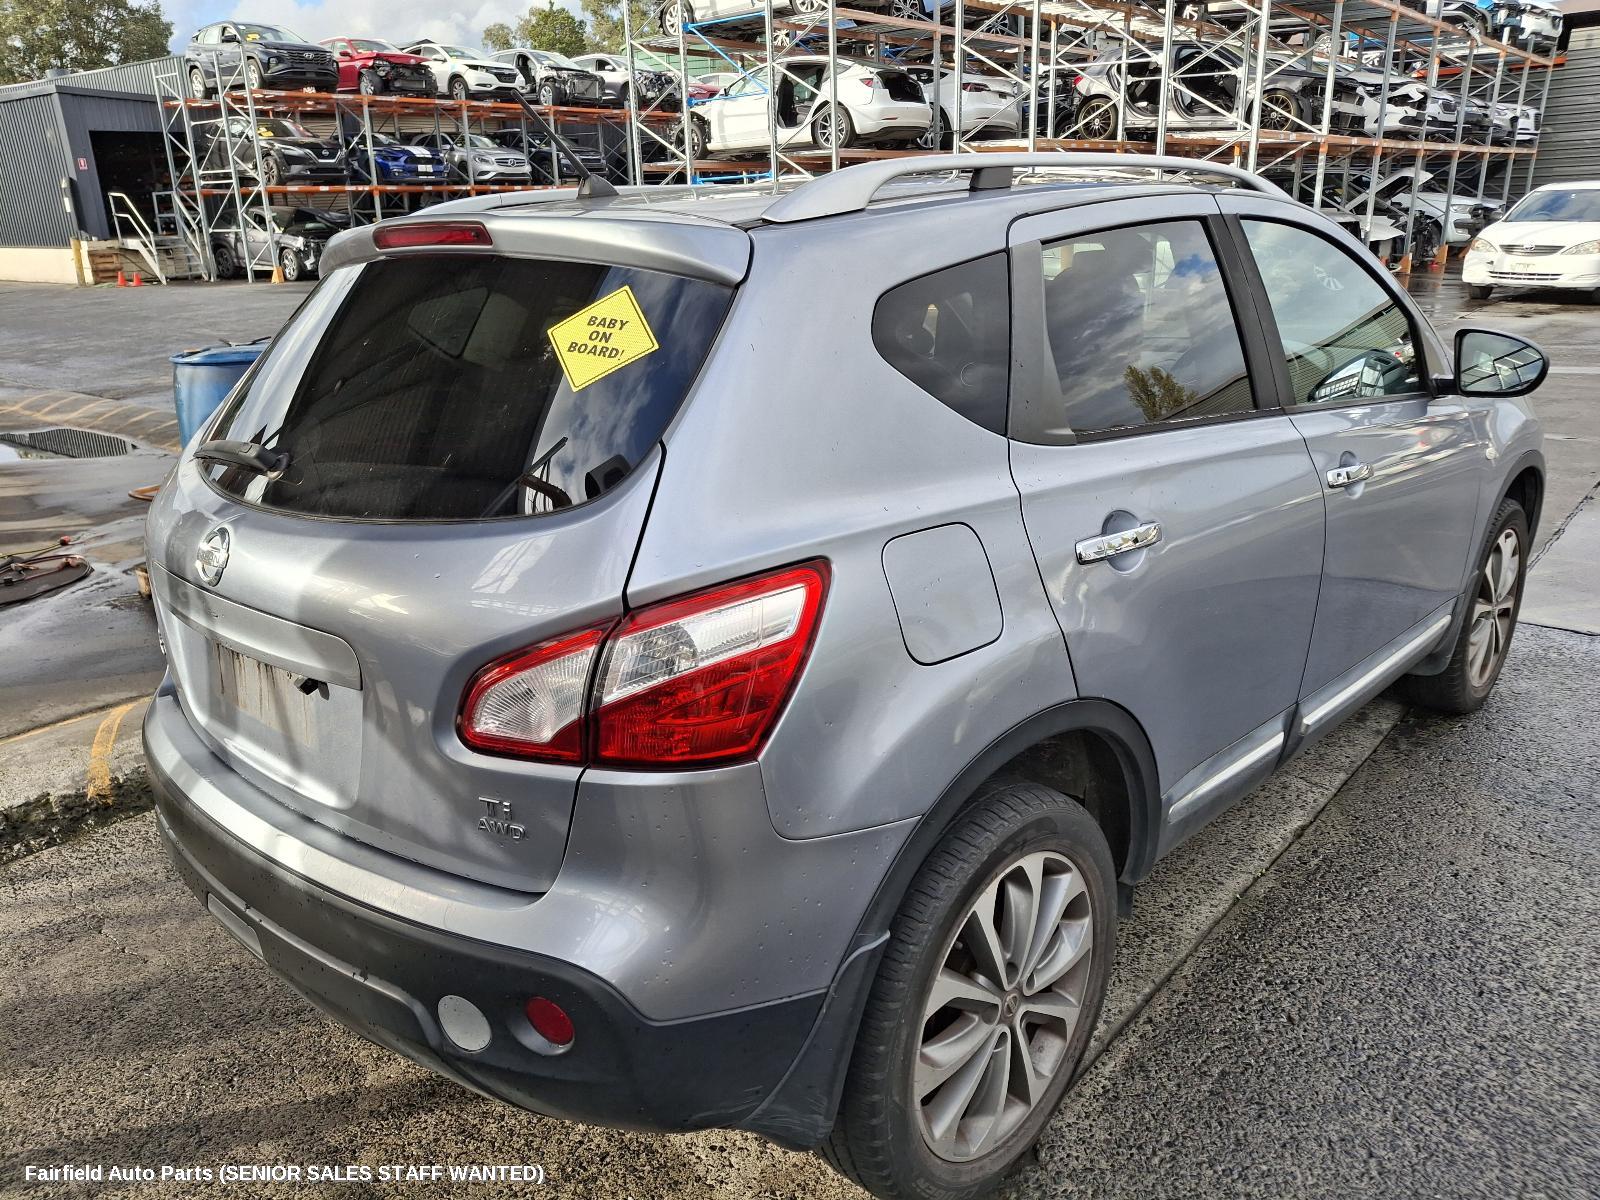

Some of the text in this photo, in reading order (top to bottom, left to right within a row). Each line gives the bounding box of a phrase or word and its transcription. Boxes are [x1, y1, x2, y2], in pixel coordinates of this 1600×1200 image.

[587, 316, 629, 330] BABY
[588, 331, 612, 343] ON
[567, 342, 624, 360] BOARD!
[478, 796, 512, 820] Ti
[478, 817, 525, 840] AWD
